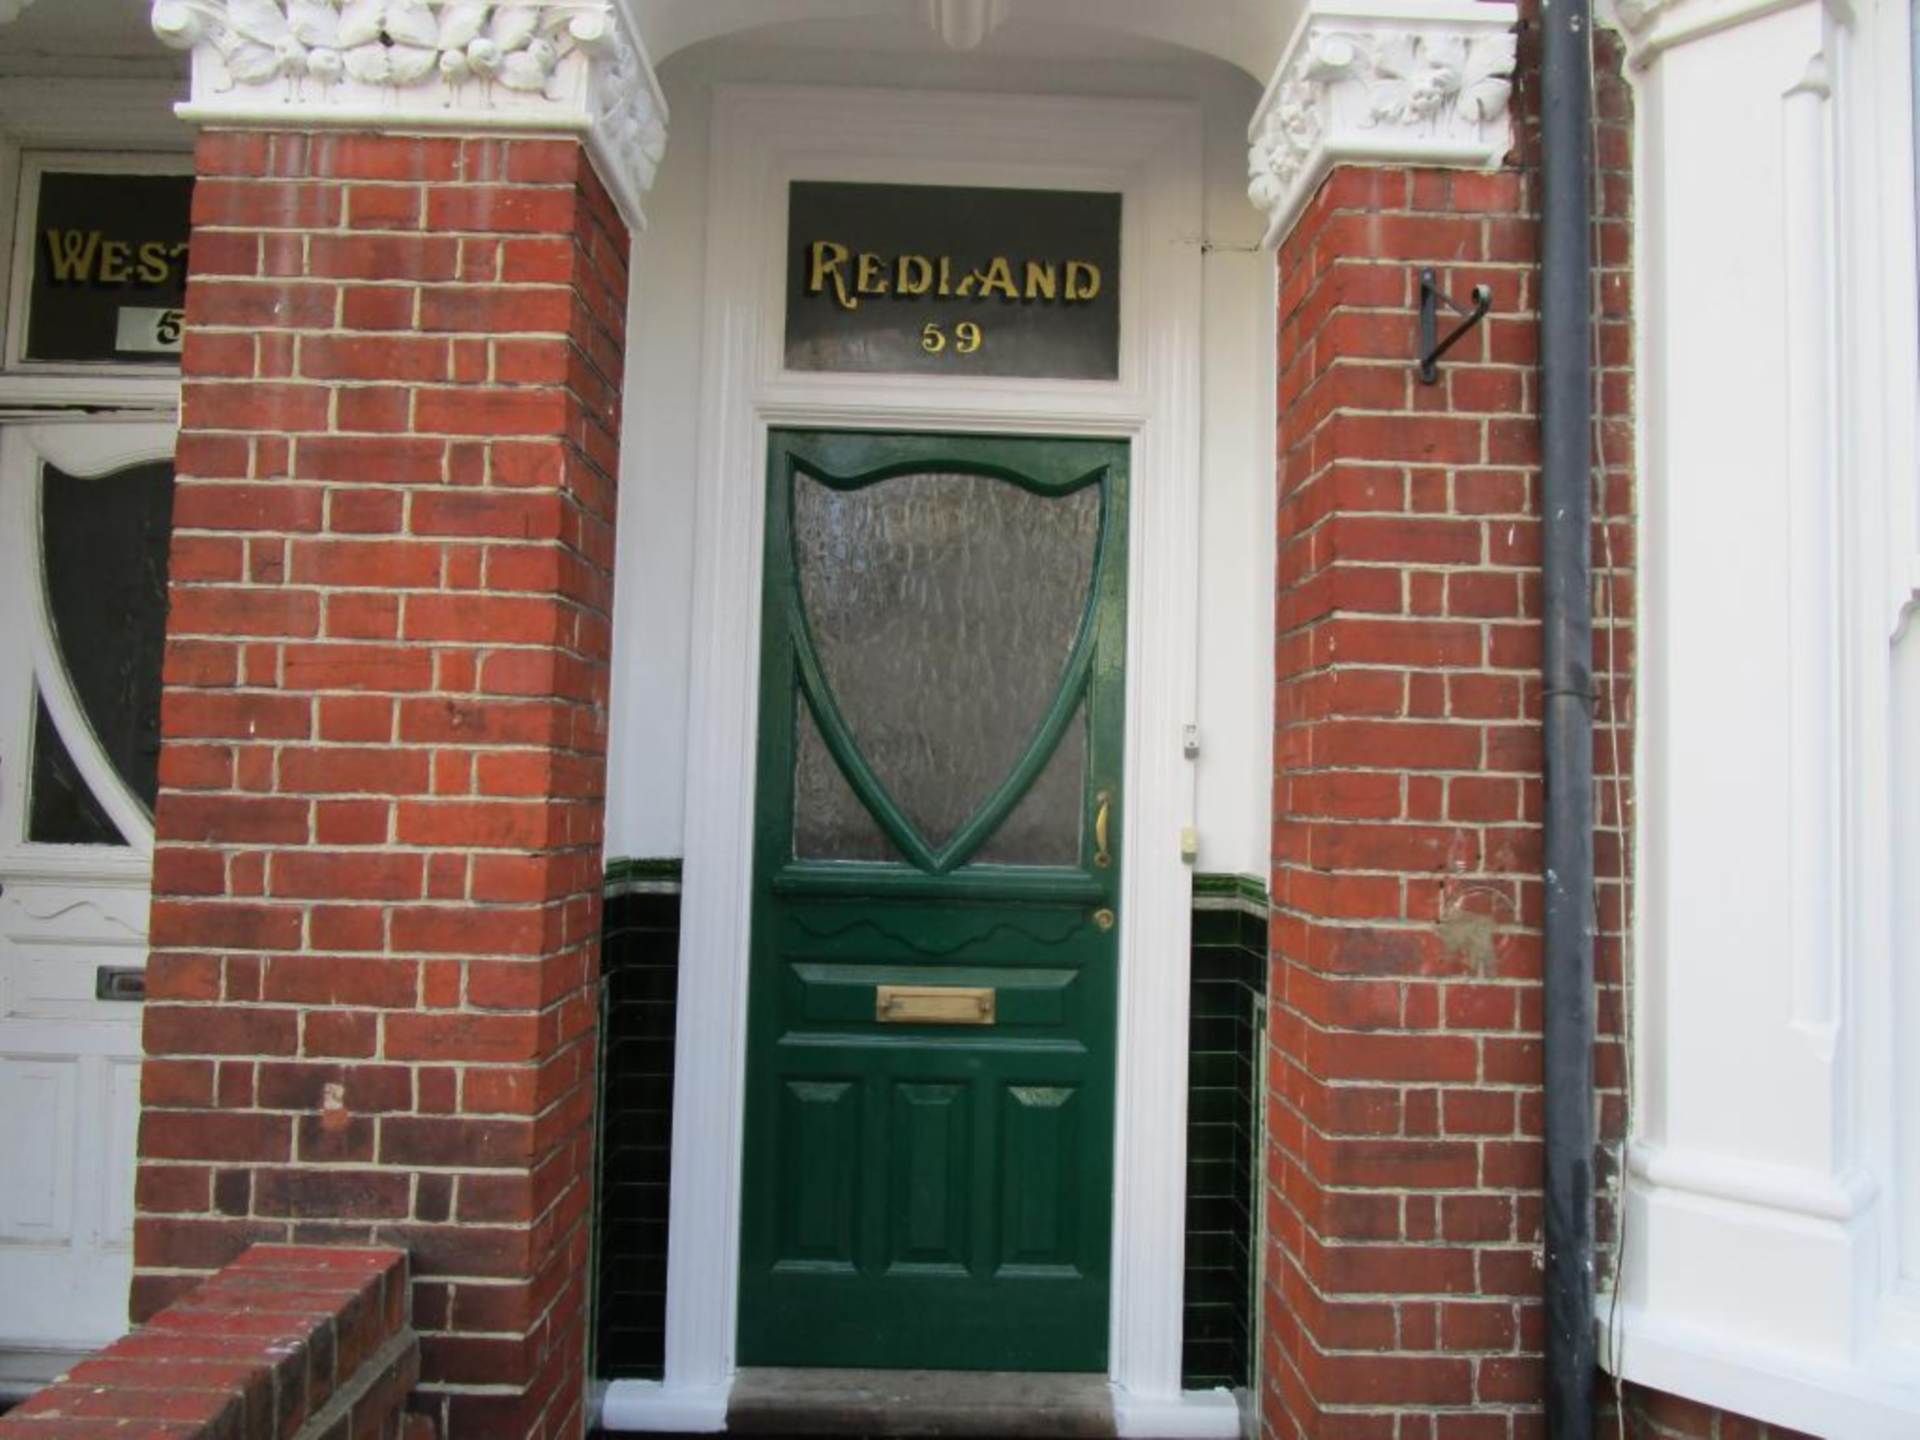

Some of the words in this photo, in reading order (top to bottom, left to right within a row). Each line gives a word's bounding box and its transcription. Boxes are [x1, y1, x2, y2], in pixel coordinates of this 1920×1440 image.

[47, 229, 189, 282] WES
[809, 240, 1100, 309] REDLAND
[921, 320, 983, 353] 59
